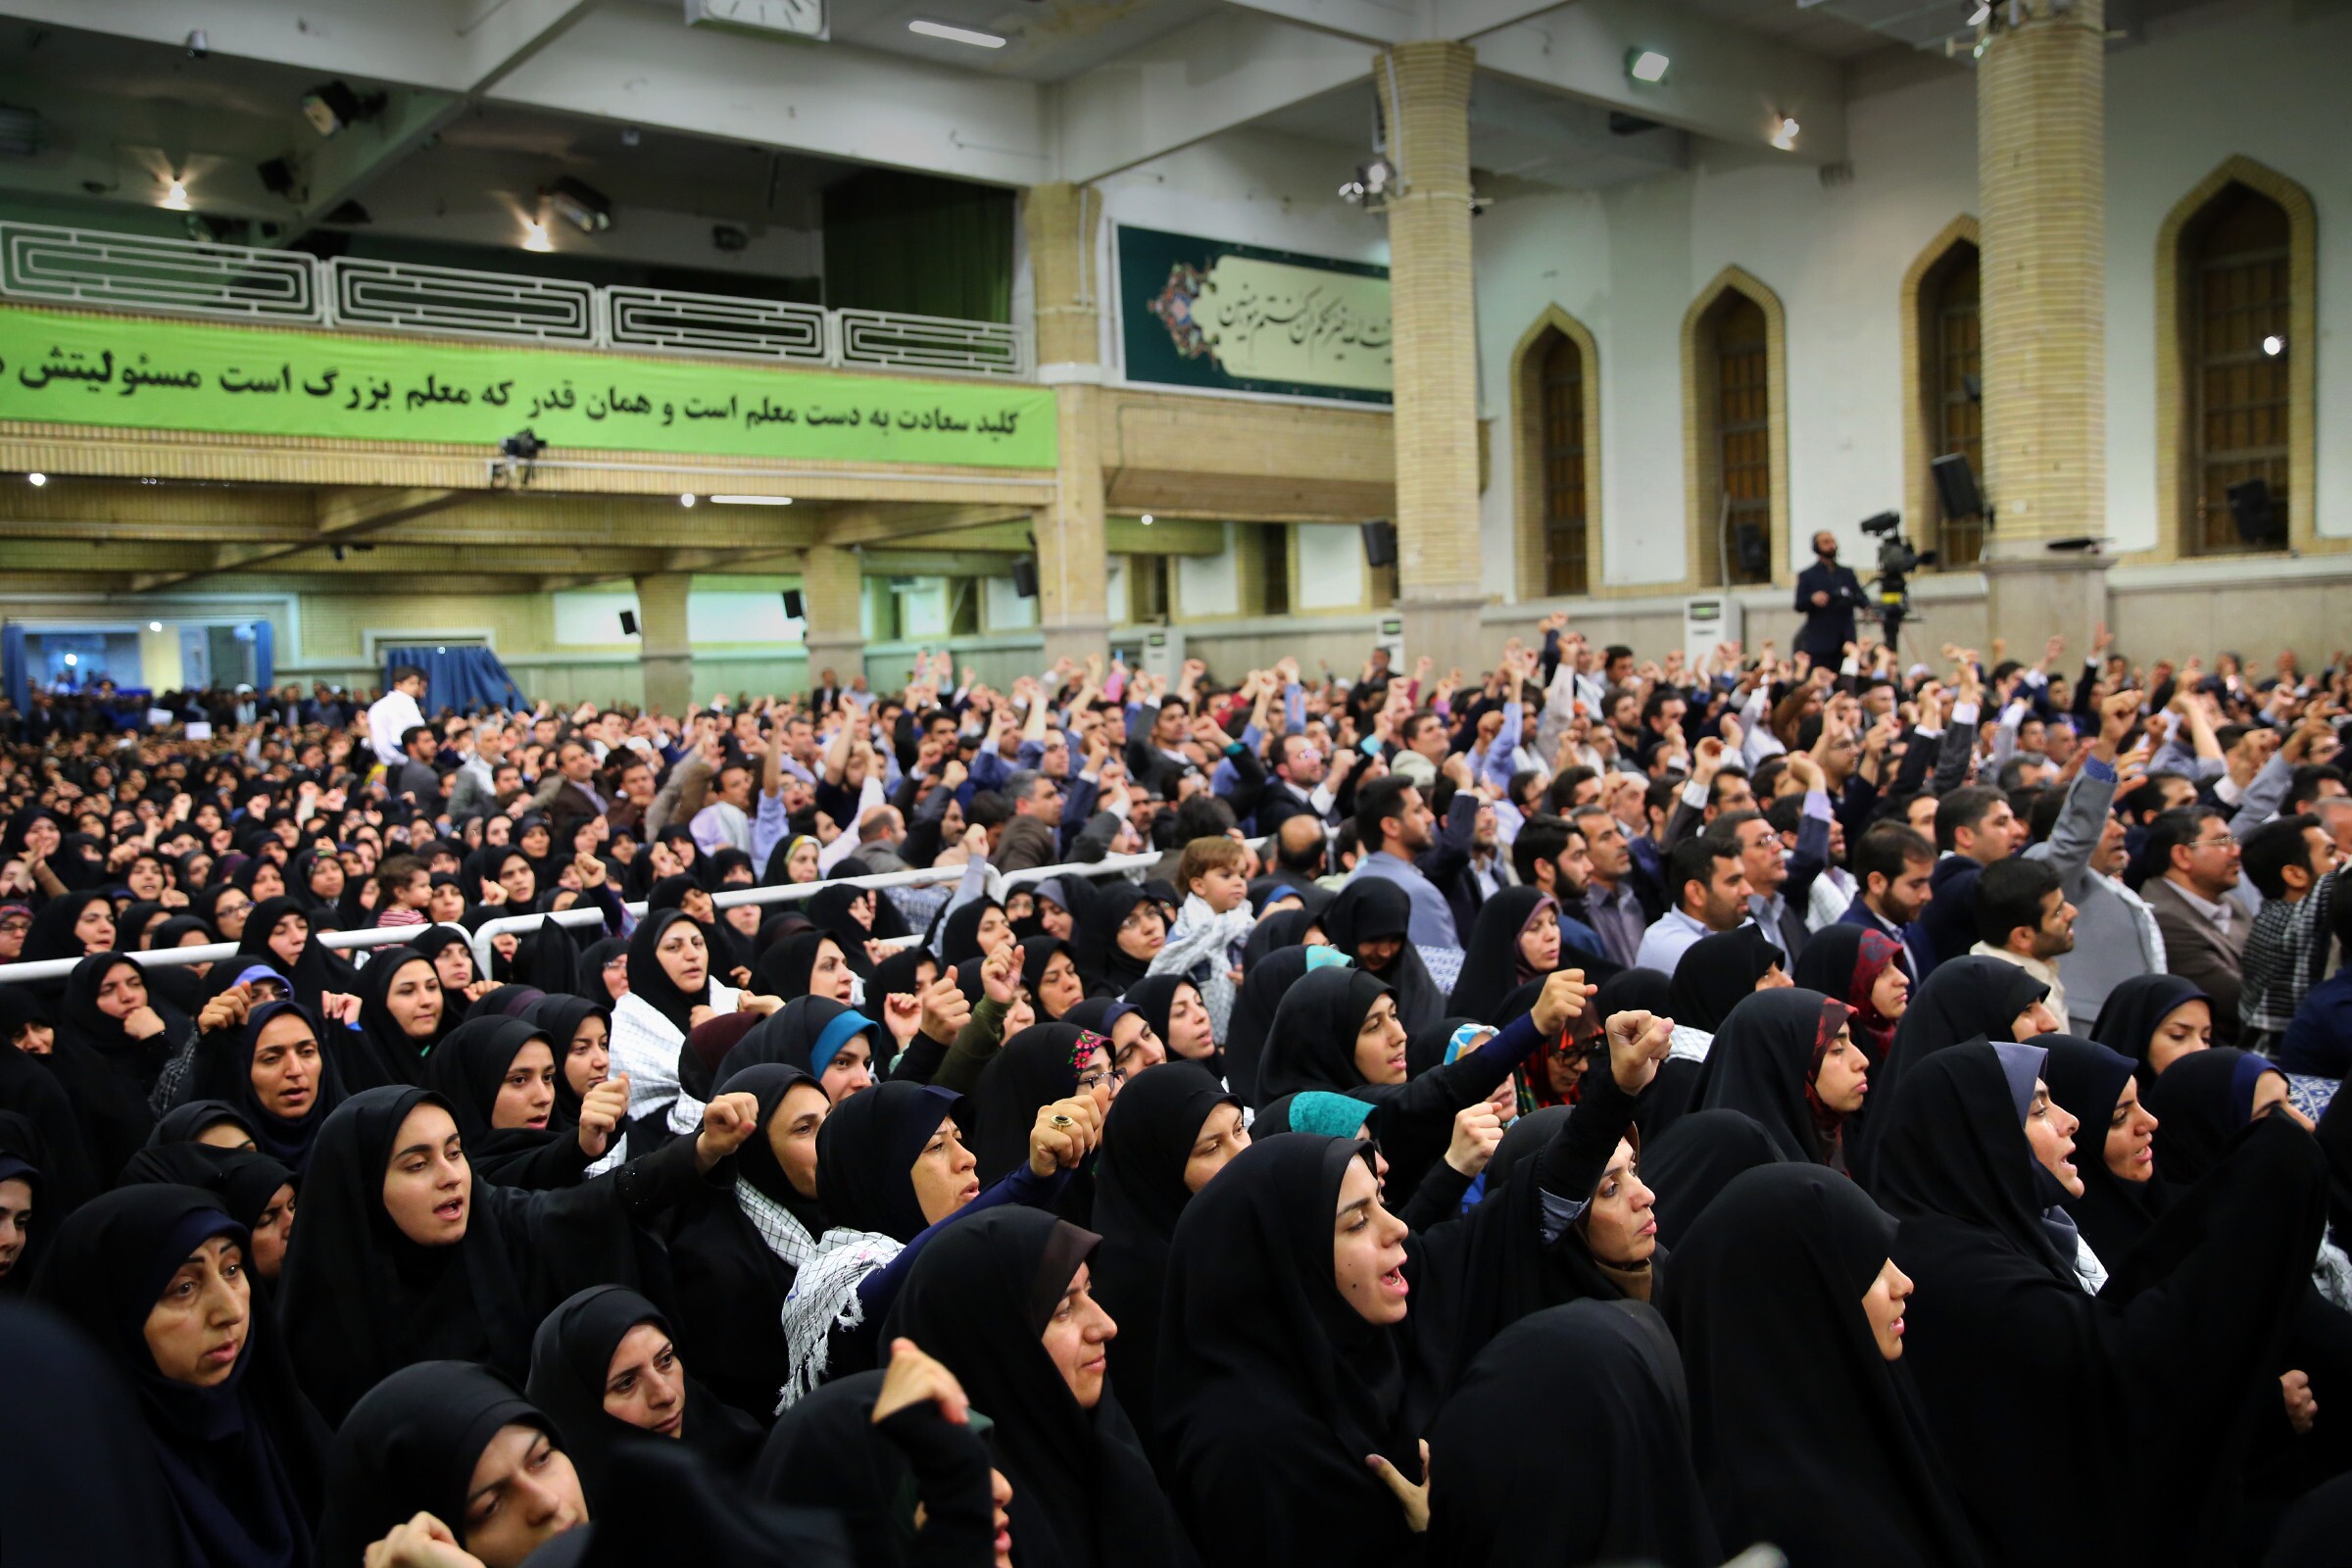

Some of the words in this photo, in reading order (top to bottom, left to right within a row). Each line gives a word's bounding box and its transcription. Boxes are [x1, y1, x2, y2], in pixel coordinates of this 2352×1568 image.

[18, 345, 203, 397] مسئولیتش
[219, 363, 293, 395] است
[303, 367, 392, 412] بزرگ
[406, 373, 472, 413] معلم
[479, 379, 515, 408] که
[526, 379, 577, 419] قدر
[585, 385, 653, 421] همان
[662, 401, 675, 426] و
[683, 394, 739, 421] است
[746, 396, 798, 430] معلم
[805, 405, 861, 427] دست
[868, 410, 891, 436] به
[897, 407, 970, 432] سعادت
[976, 412, 1019, 442] کلید
